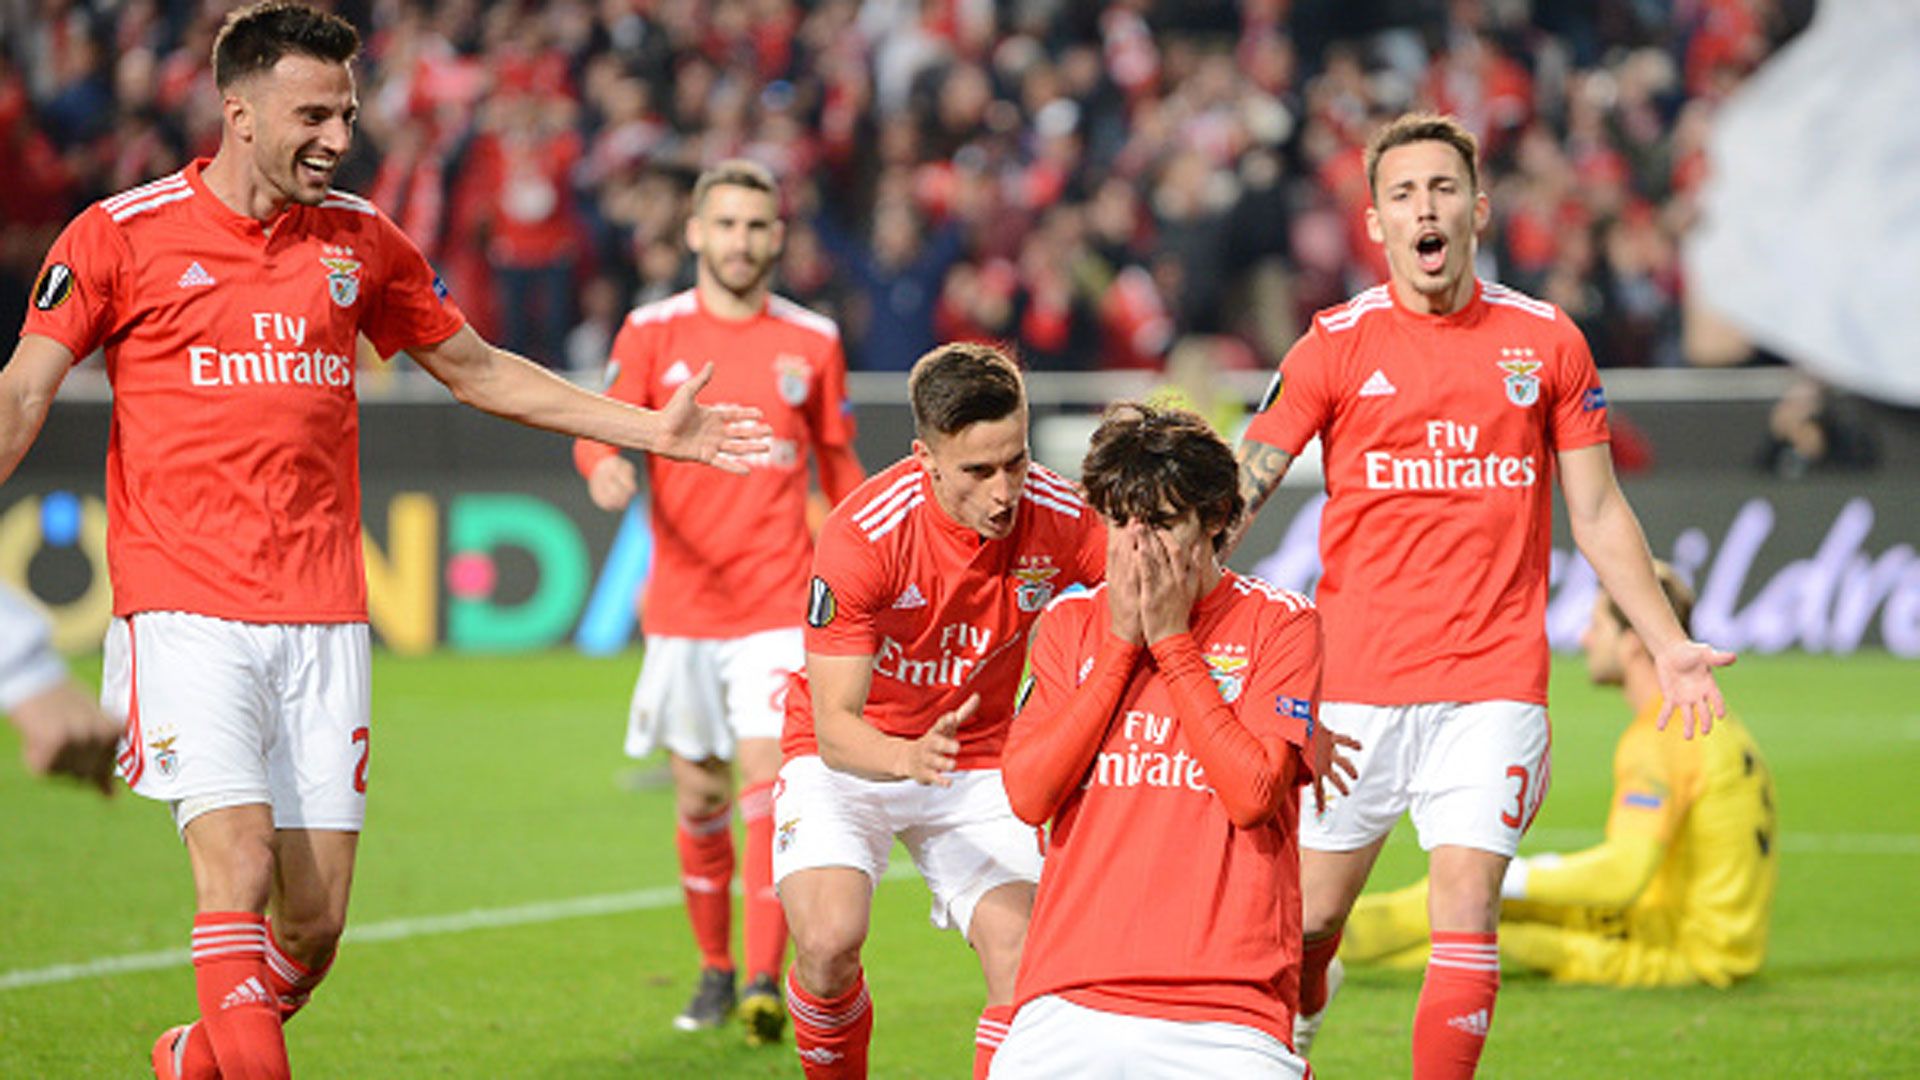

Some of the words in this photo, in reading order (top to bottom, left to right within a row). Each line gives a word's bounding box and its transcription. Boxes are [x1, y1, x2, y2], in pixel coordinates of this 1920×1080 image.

[252, 312, 306, 346] Fly
[188, 342, 350, 386] Emirates
[1427, 420, 1479, 452] Fly
[1365, 449, 1536, 489] Emirates
[940, 622, 991, 655] Fly
[873, 636, 985, 687] Emir
[1124, 710, 1171, 745] Fly
[351, 726, 369, 795] 2
[1083, 743, 1216, 792] mirate
[1501, 764, 1530, 829] 3
